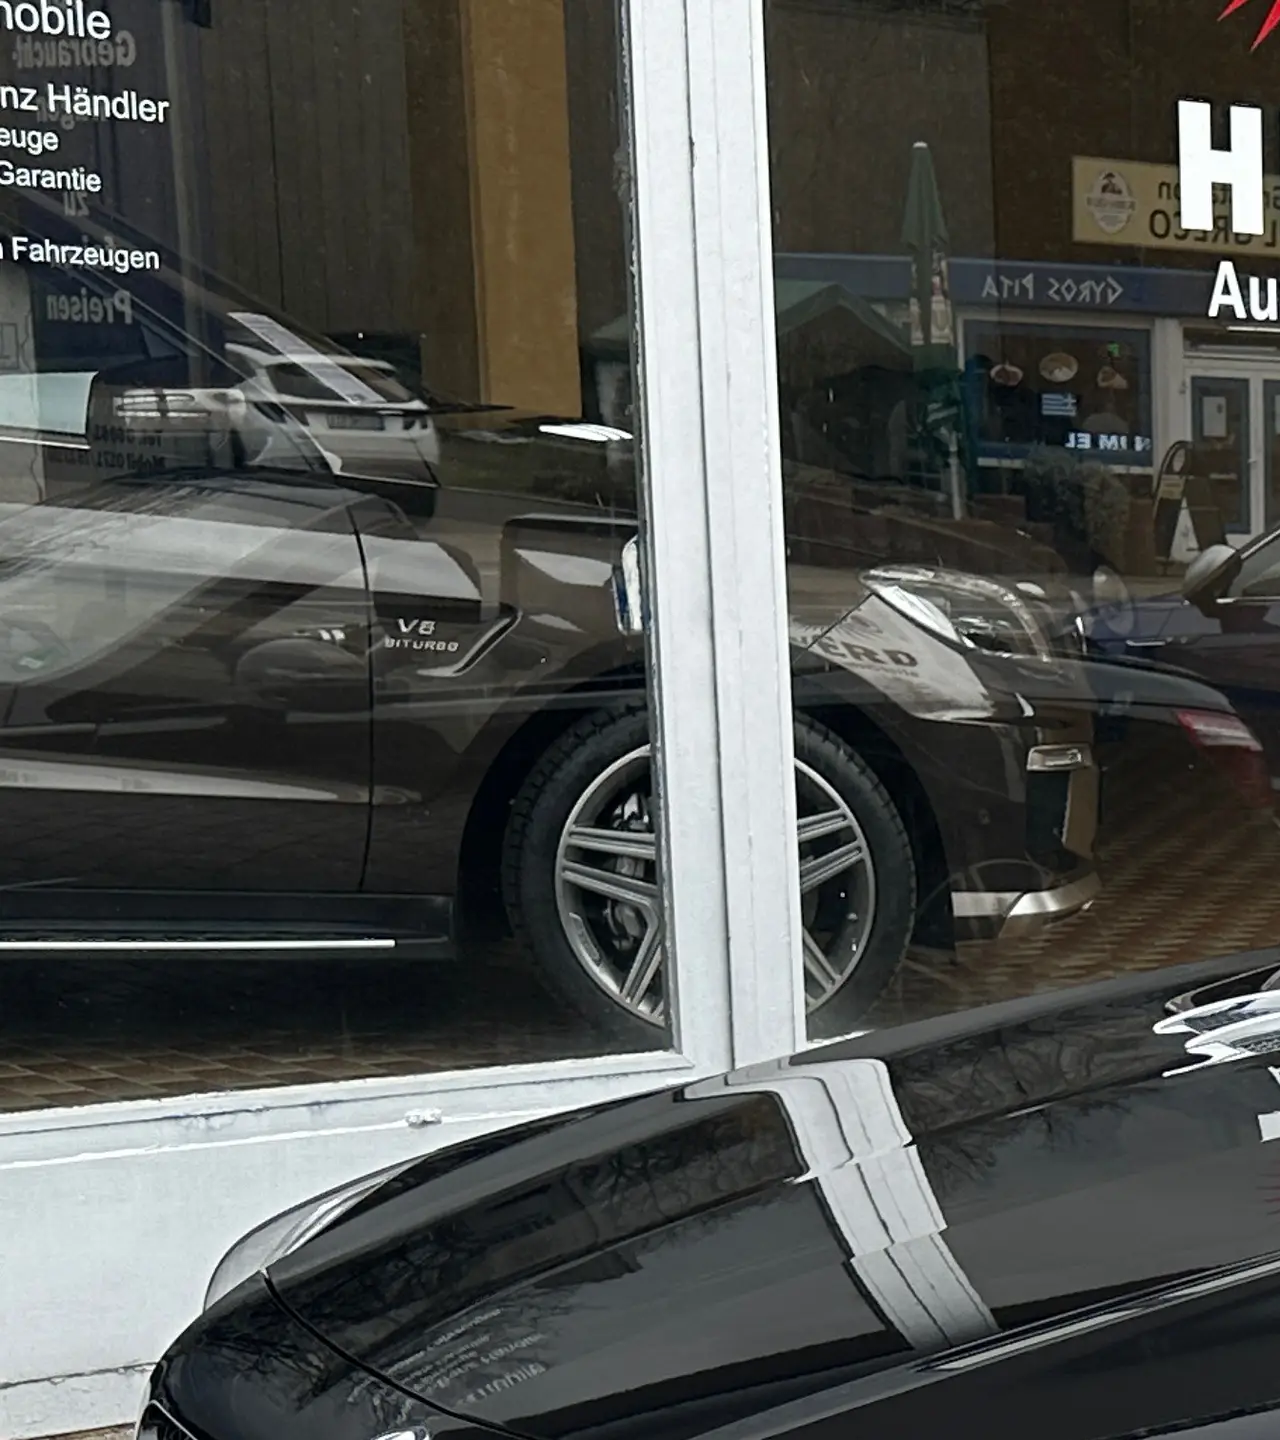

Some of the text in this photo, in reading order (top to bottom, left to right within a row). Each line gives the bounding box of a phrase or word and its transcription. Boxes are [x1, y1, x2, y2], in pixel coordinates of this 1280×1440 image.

[48, 84, 170, 123] Händler
[0, 161, 101, 192] Garantie
[12, 236, 160, 273] Fahrzeugen
[398, 618, 436, 635] V8
